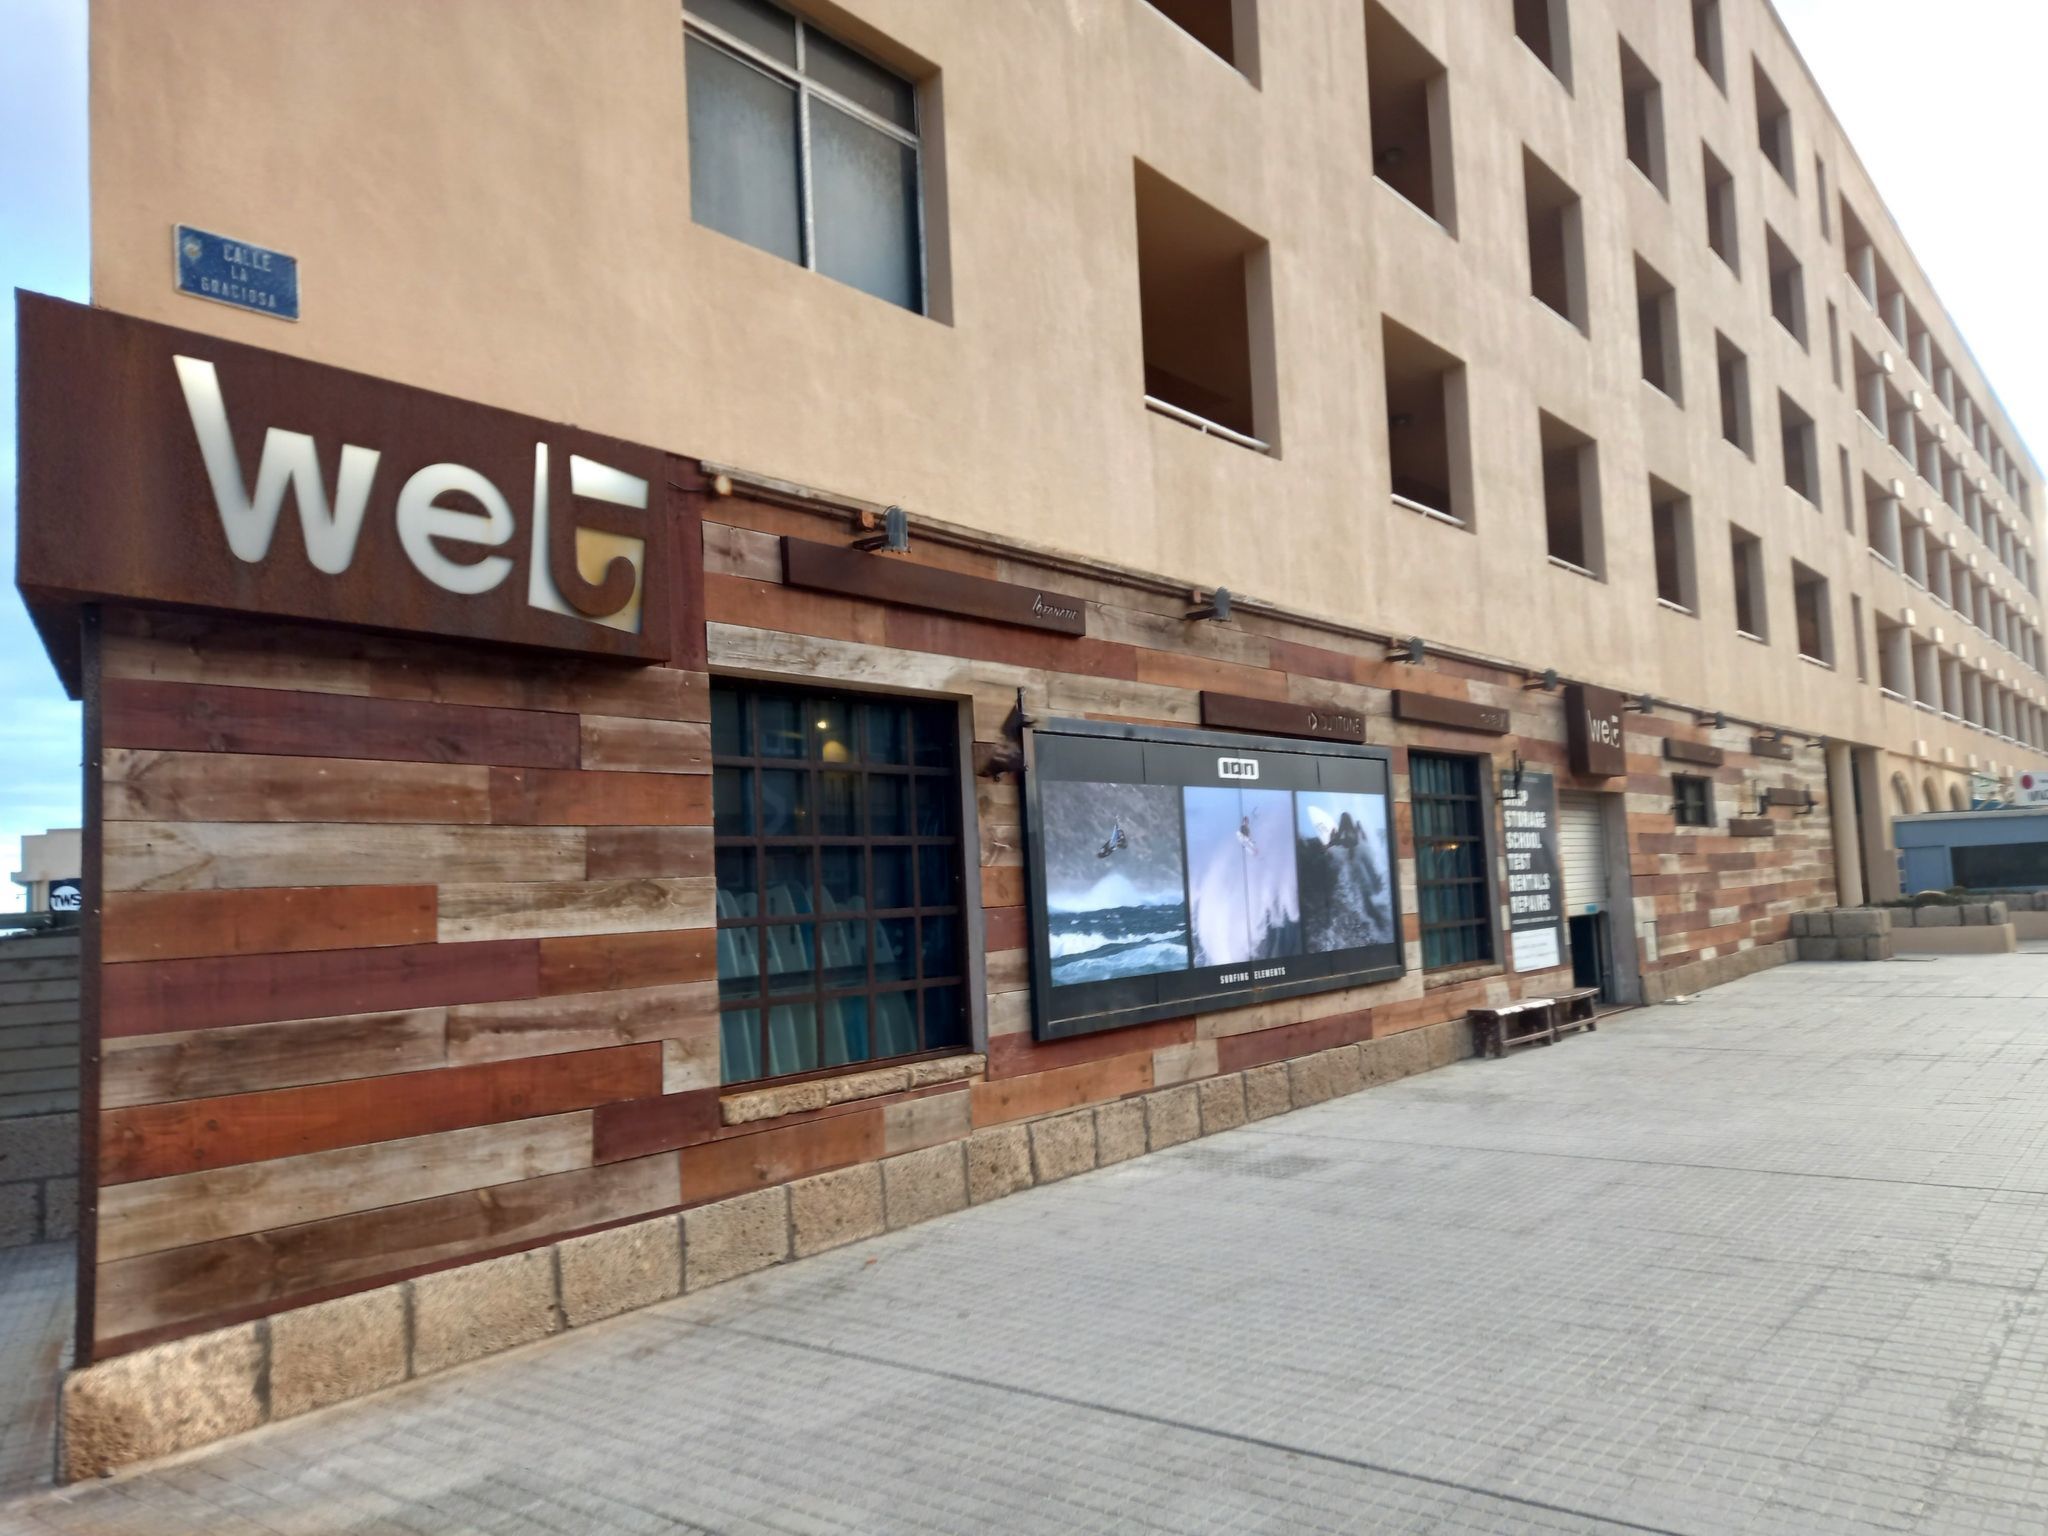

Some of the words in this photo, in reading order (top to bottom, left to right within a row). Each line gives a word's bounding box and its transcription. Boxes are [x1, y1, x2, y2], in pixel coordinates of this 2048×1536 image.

[223, 243, 272, 272] CALLE
[231, 265, 247, 282] LA
[201, 276, 276, 308] GRACIOSA
[1504, 810, 1546, 828] STORAGE
[1505, 831, 1542, 849] SCHOOL
[1507, 853, 1531, 870] TEST
[1508, 873, 1551, 892] RENTALS
[1510, 894, 1551, 914] REPAIRS
[1220, 972, 1249, 985] SURFING
[1254, 966, 1286, 980] ELEMENTS
